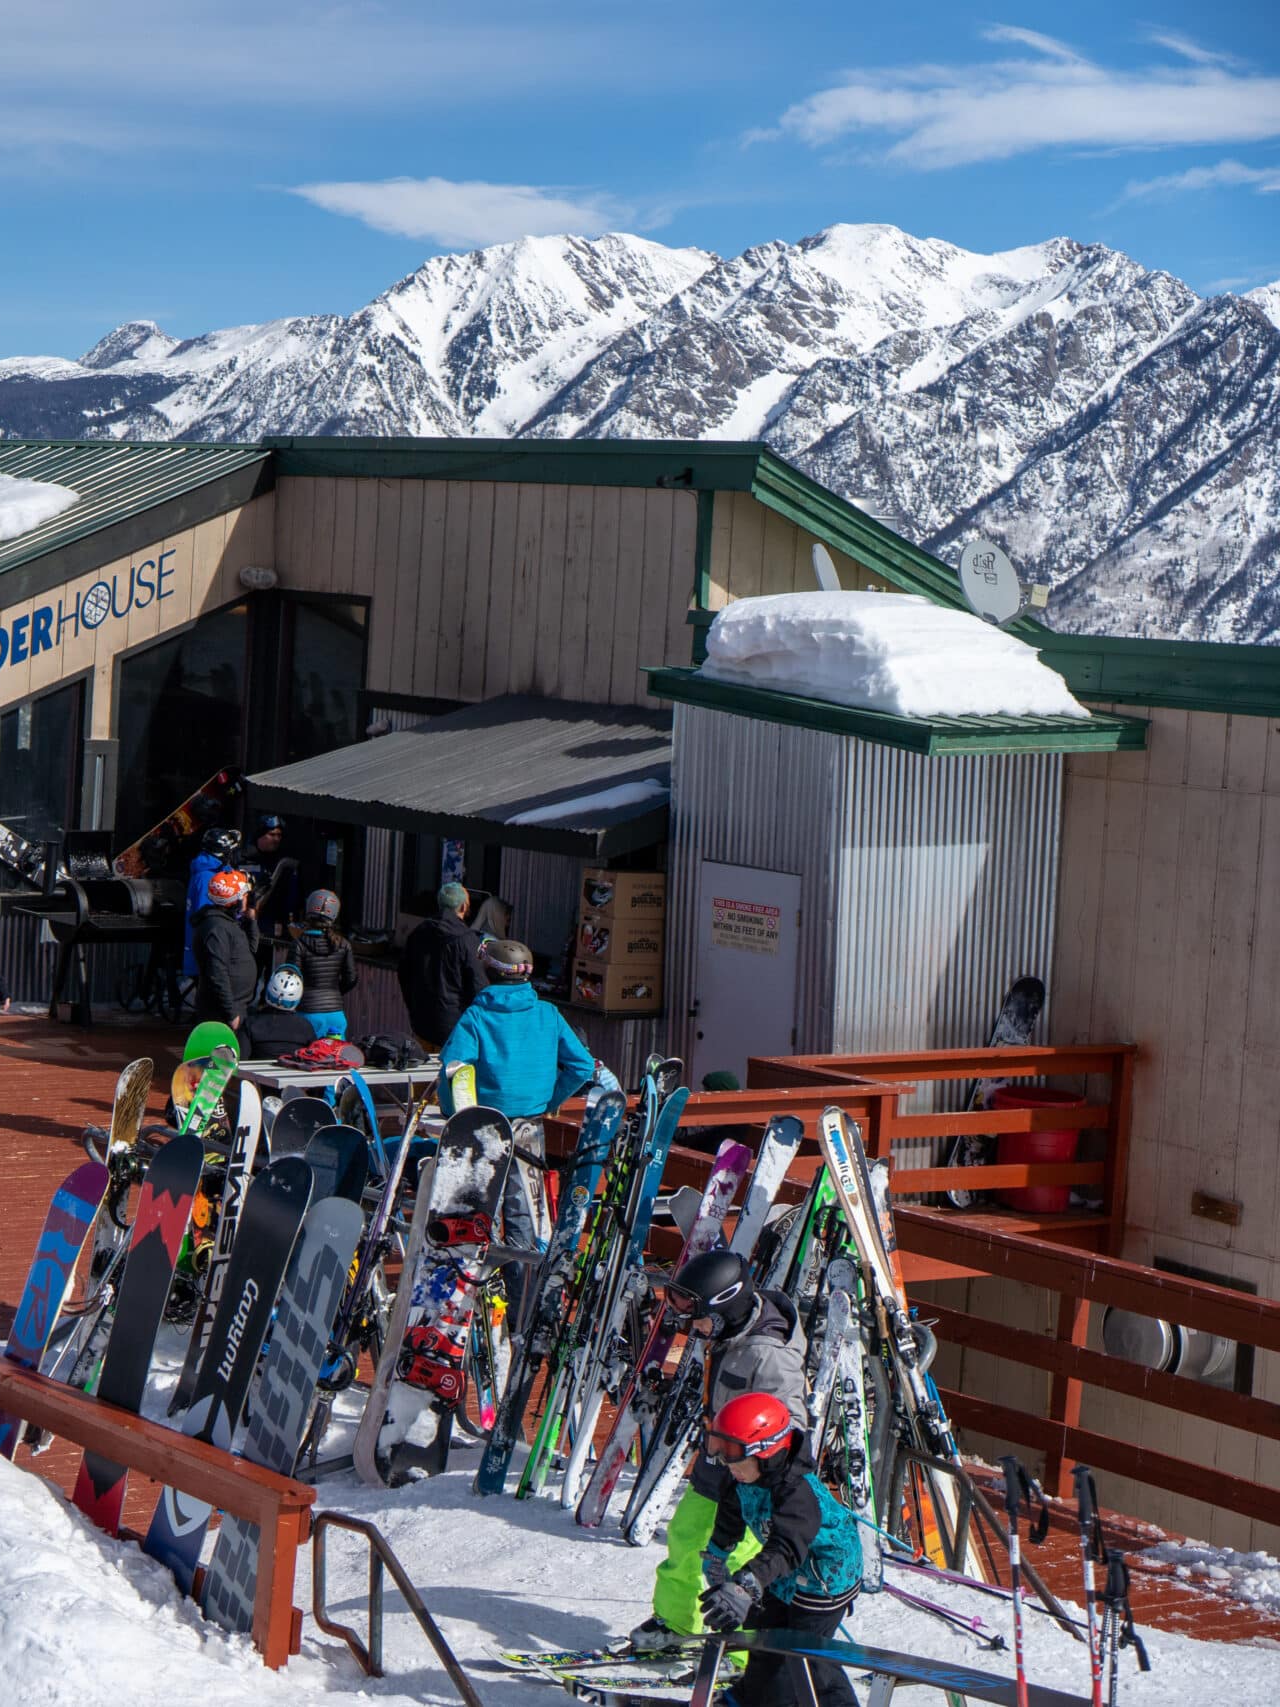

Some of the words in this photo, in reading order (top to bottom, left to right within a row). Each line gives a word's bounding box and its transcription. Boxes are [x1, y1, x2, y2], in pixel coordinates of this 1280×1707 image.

[727, 912, 736, 920] NO
[737, 914, 764, 925] SMOKING
[742, 926, 756, 936] FEET
[766, 930, 778, 939] ANY
